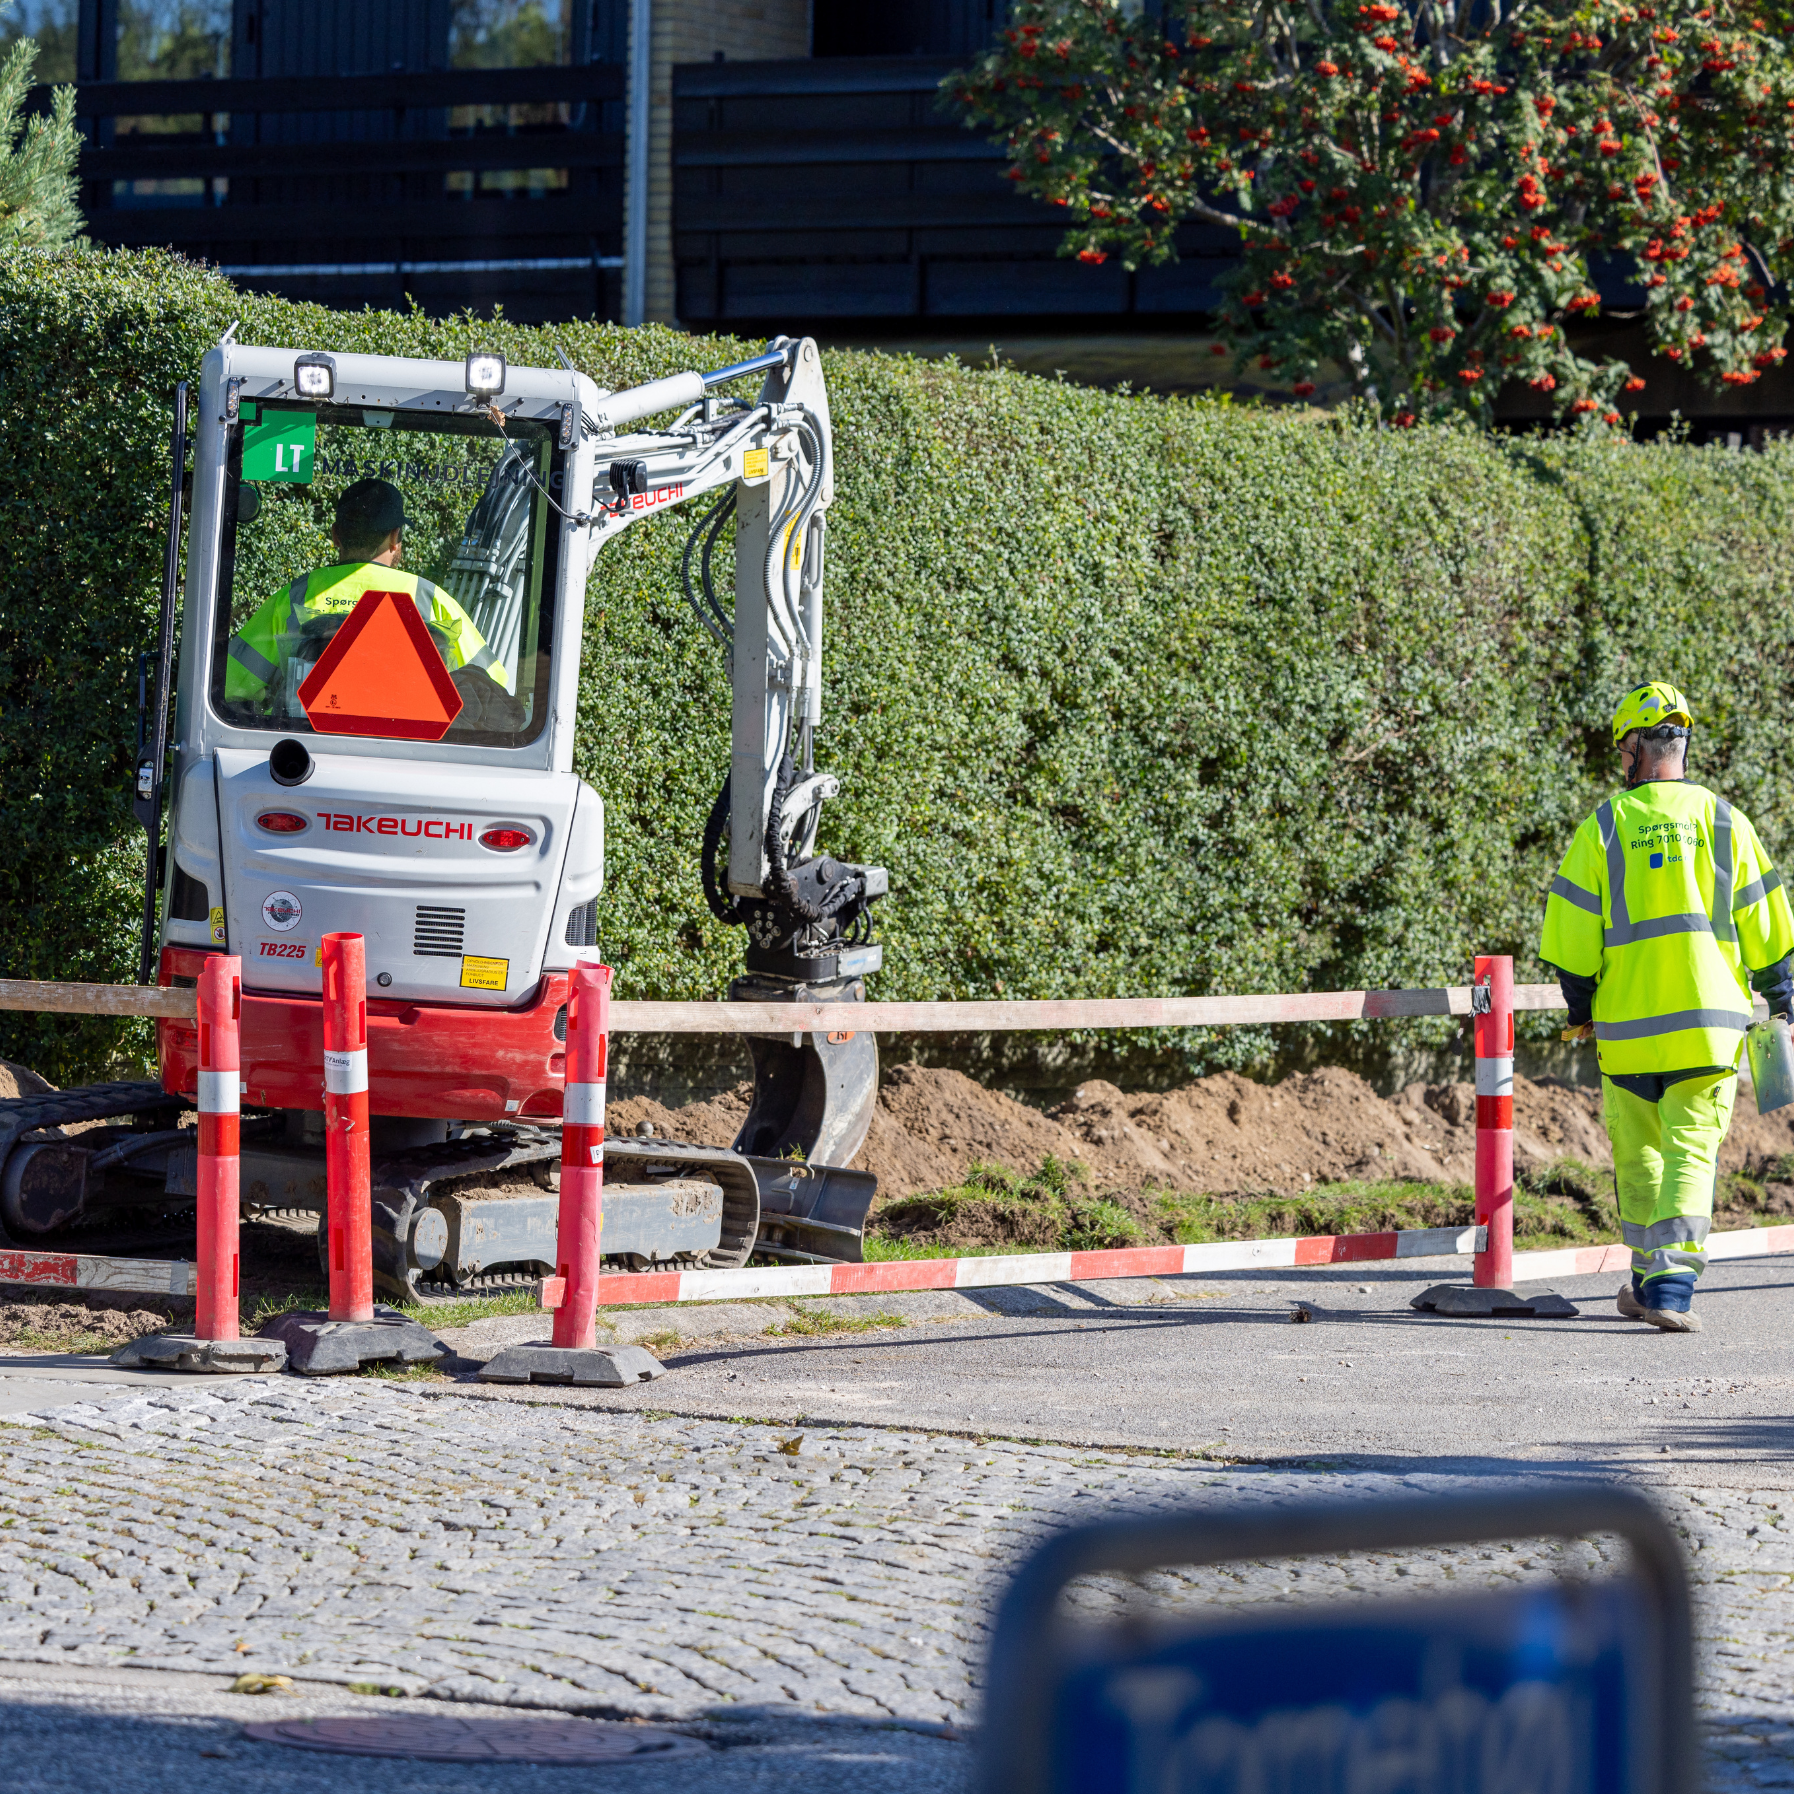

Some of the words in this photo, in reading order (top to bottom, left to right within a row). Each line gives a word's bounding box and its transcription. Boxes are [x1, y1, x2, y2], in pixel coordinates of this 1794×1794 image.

[275, 443, 305, 473] LT
[322, 457, 564, 490] MASKINUDLEJNING
[1638, 821, 1698, 834] Spørgsmål?
[1631, 838, 1654, 850] Ring
[1667, 855, 1683, 863] tdc
[259, 942, 306, 959] TB225
[469, 978, 499, 986] LIVSFARE
